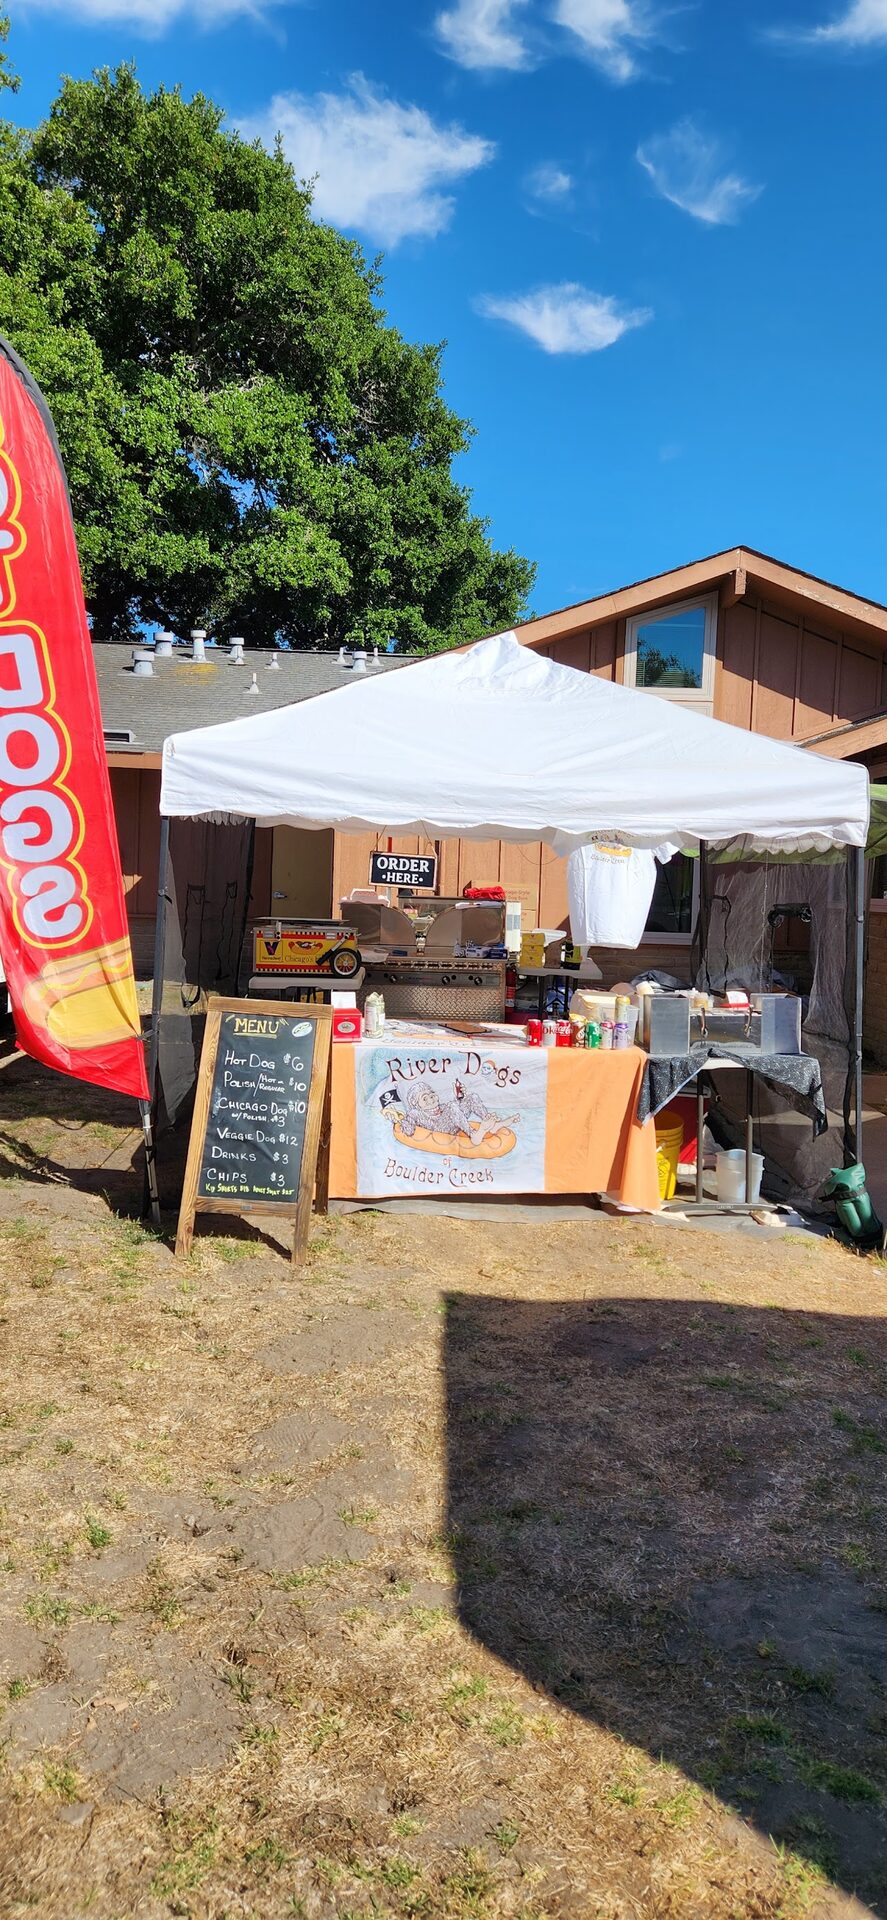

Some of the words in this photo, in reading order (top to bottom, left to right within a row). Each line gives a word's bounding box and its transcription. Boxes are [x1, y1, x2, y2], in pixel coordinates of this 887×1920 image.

[377, 857, 430, 873] ORDER
[387, 873, 418, 884] HERE
[234, 1018, 279, 1033] MENU
[283, 1053, 304, 1071] $6
[386, 1055, 452, 1083] River
[289, 1077, 307, 1092] $10
[288, 1100, 306, 1114] $10
[278, 1133, 299, 1147] $12
[273, 1152, 289, 1164] $3
[207, 1168, 248, 1184] CHIPS
[270, 1172, 286, 1187] $3
[384, 1157, 444, 1184] Boulder
[448, 1168, 494, 1188] Creek
